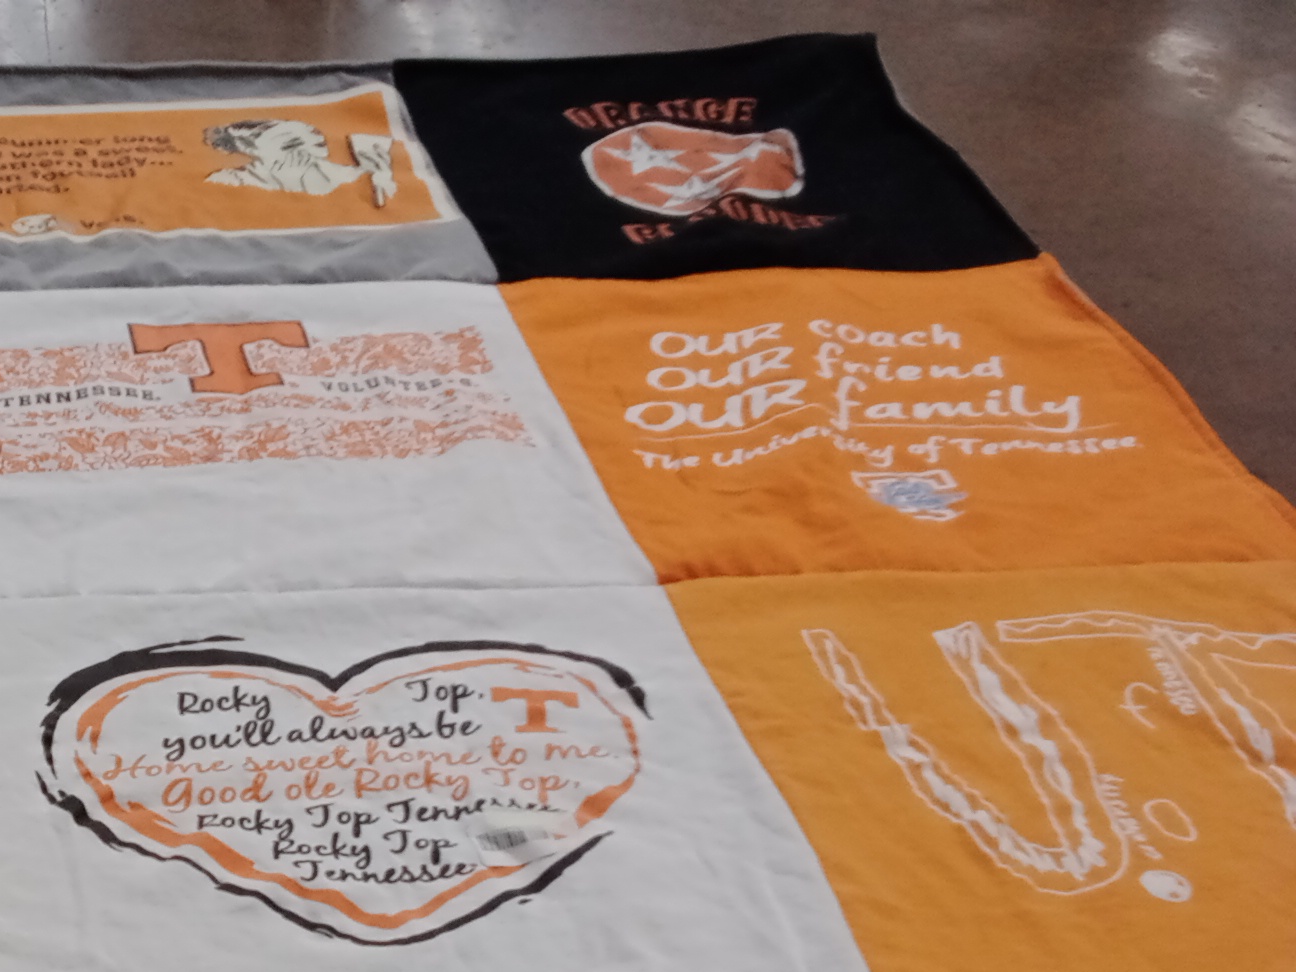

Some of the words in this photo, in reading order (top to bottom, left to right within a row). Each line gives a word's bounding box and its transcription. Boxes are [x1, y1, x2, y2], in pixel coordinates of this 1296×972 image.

[126, 320, 309, 393] T
[649, 322, 784, 359] OUR
[808, 318, 962, 350] coach
[646, 346, 795, 391] OUR
[813, 341, 1004, 380] friend
[624, 379, 807, 431] OUR
[829, 375, 1081, 433] family
[633, 449, 701, 470] The
[907, 435, 945, 463] of
[947, 435, 1141, 456] Tennessee
[176, 685, 271, 720] Rocky
[490, 686, 579, 733] T
[103, 753, 233, 780] Home
[242, 744, 357, 773] sweet
[366, 737, 482, 765] home
[490, 735, 528, 765] to
[161, 718, 282, 762] you'll
[286, 714, 431, 748] always
[433, 709, 482, 738] be
[161, 771, 274, 814] Good
[284, 769, 344, 801] ole
[354, 760, 471, 801] Rocky
[195, 808, 294, 836] Rocky
[305, 803, 381, 838] Top
[272, 832, 373, 869] Rocky
[383, 830, 458, 865] Top
[293, 859, 478, 884] Tennessee
